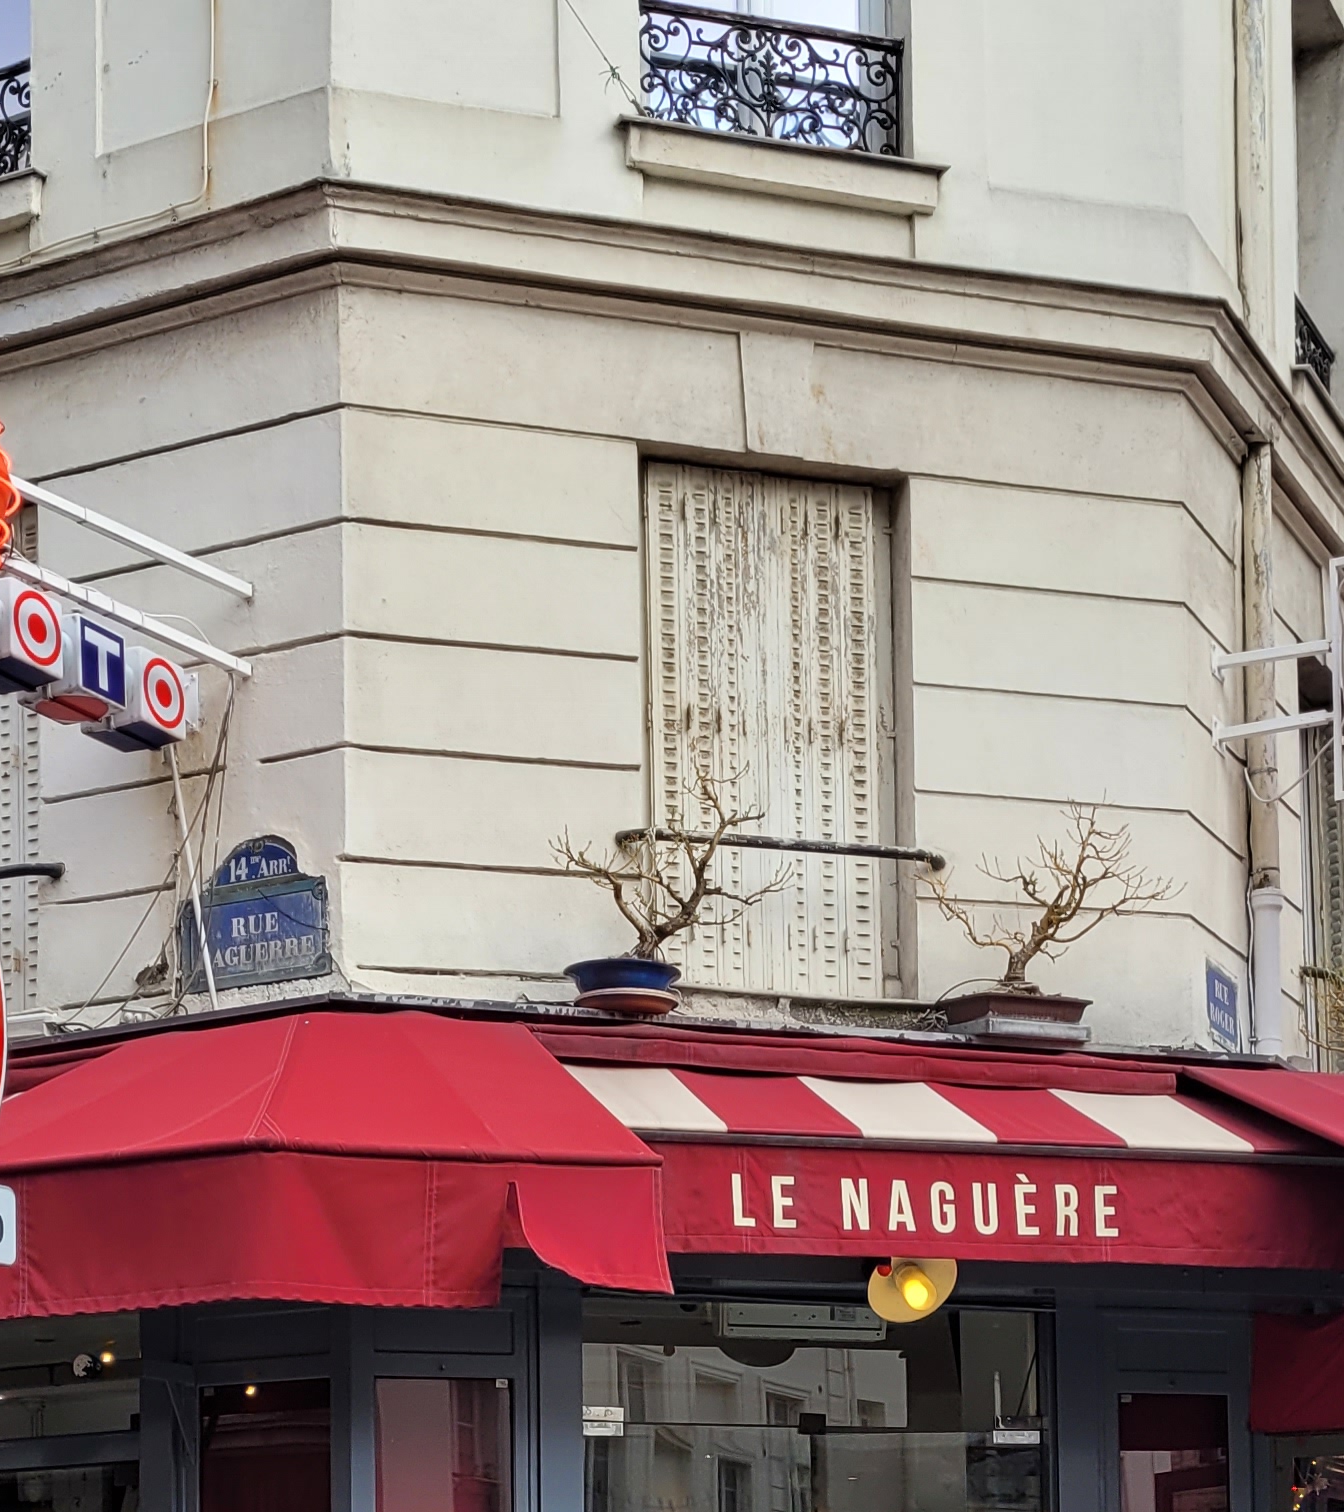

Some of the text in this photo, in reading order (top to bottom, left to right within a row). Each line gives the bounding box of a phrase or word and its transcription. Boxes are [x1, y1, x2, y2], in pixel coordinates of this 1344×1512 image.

[231, 911, 279, 938] RUE
[212, 934, 315, 969] AGUERRE
[1214, 978, 1230, 1006] RUE
[1209, 1001, 1235, 1038] ROGER
[731, 1172, 1121, 1238] LE NAGUÈRE
